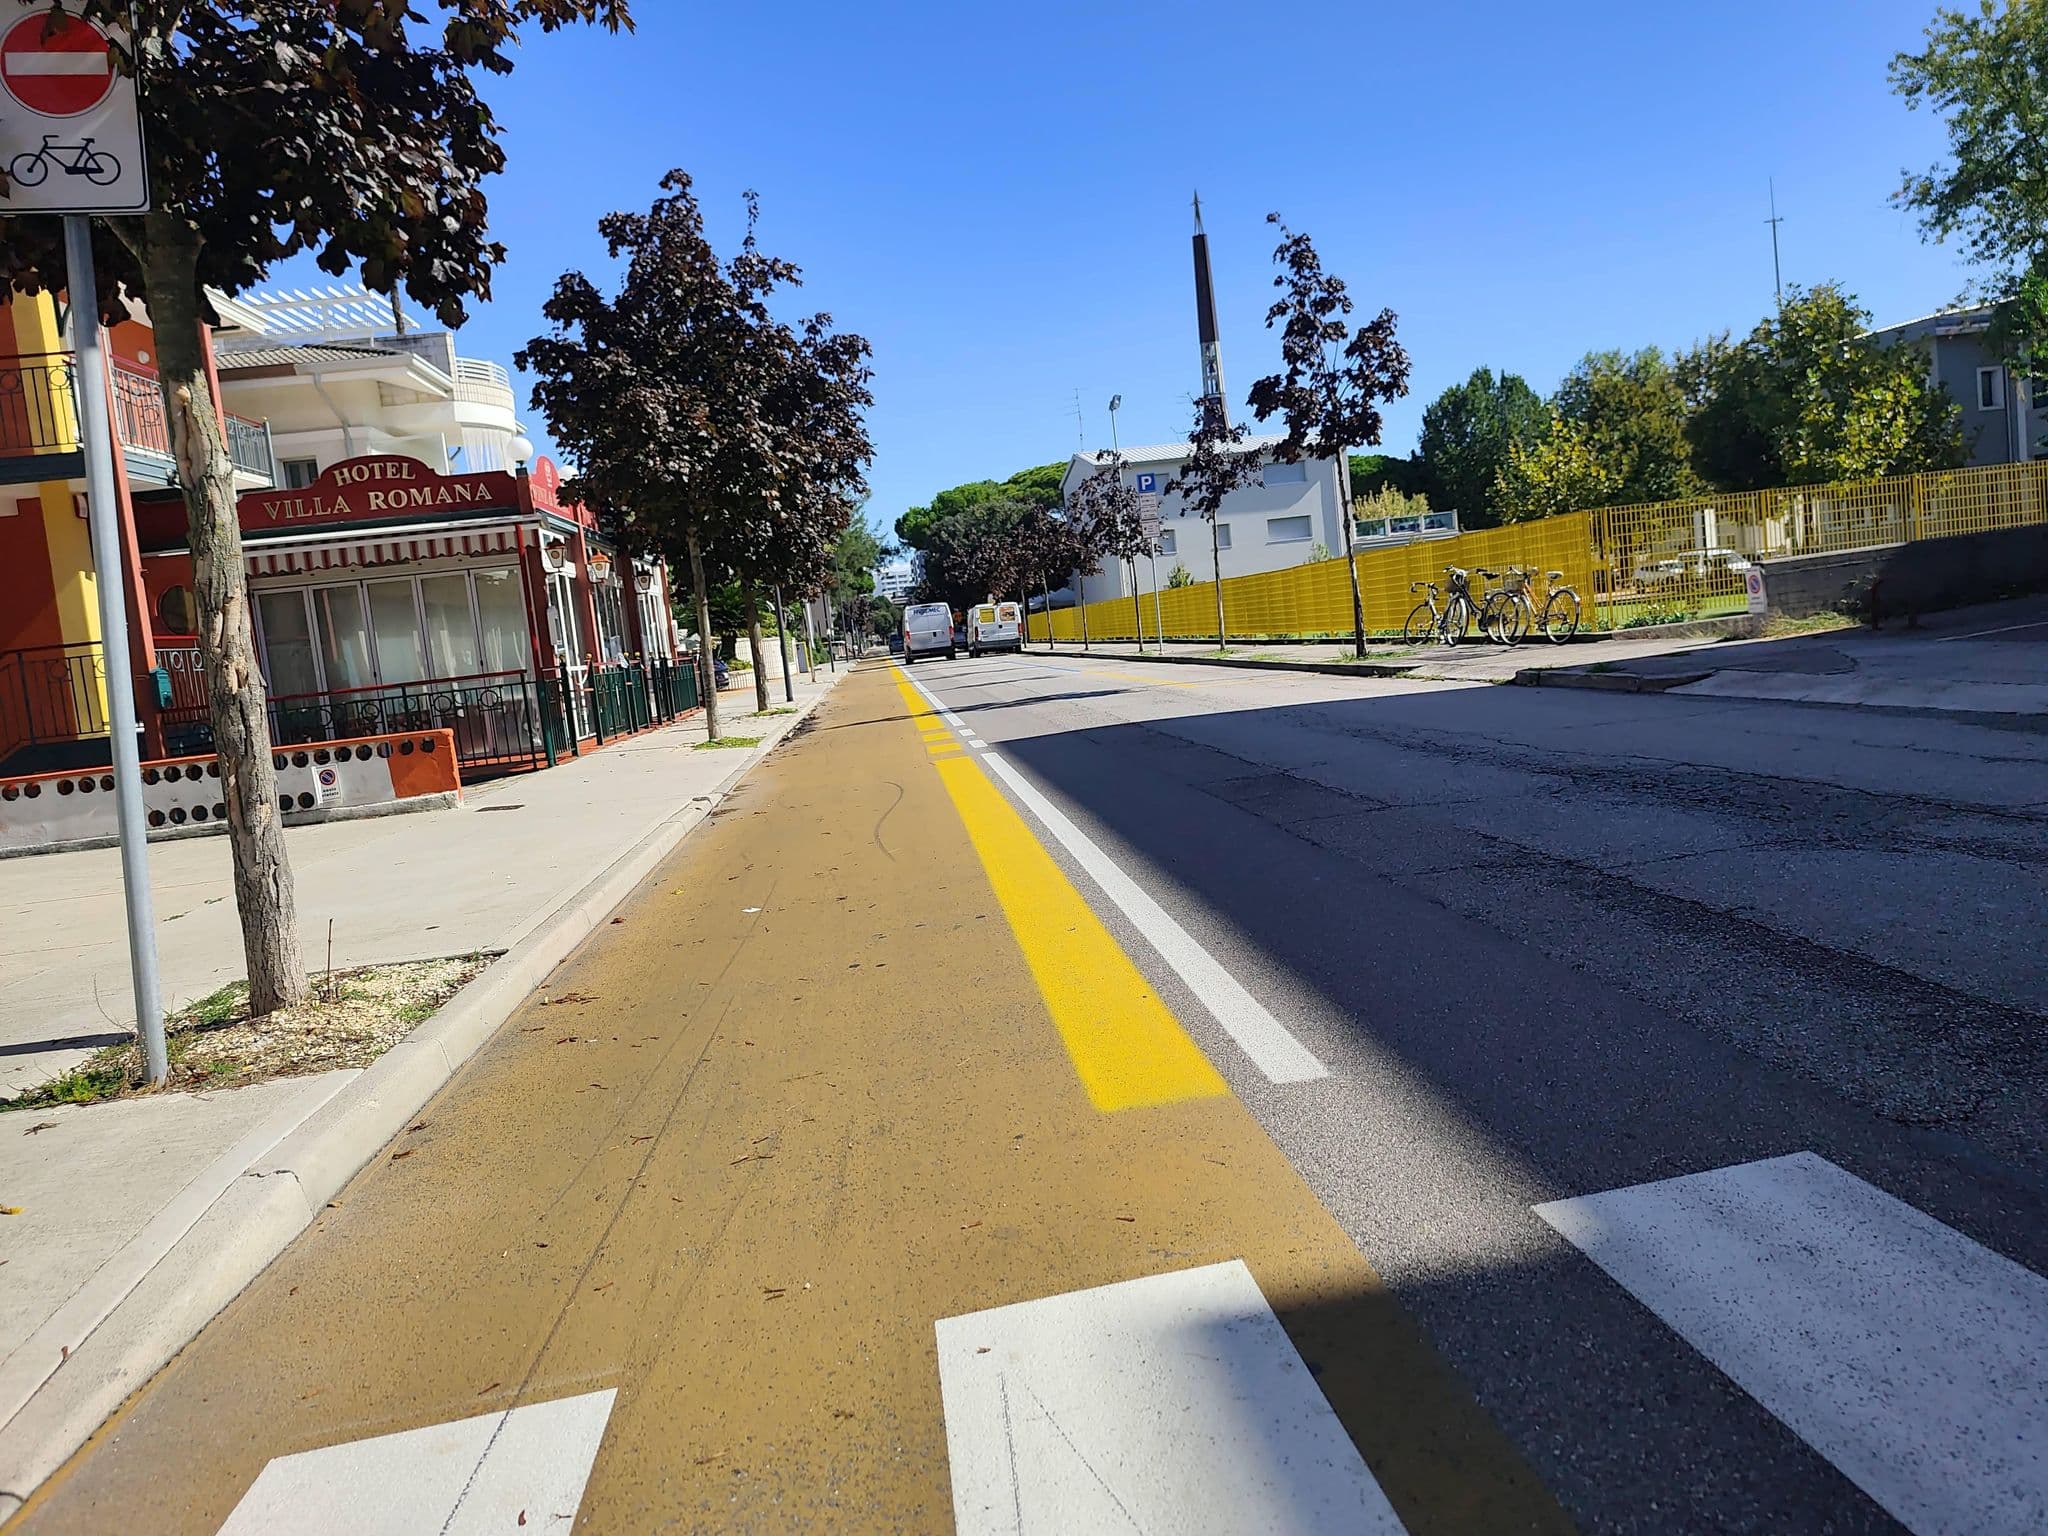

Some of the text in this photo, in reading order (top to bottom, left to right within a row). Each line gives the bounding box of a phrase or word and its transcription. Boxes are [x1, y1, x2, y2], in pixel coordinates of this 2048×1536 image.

[334, 462, 416, 487] HOTEL
[1141, 476, 1152, 490] P
[263, 482, 493, 521] VILLA ROMANA
